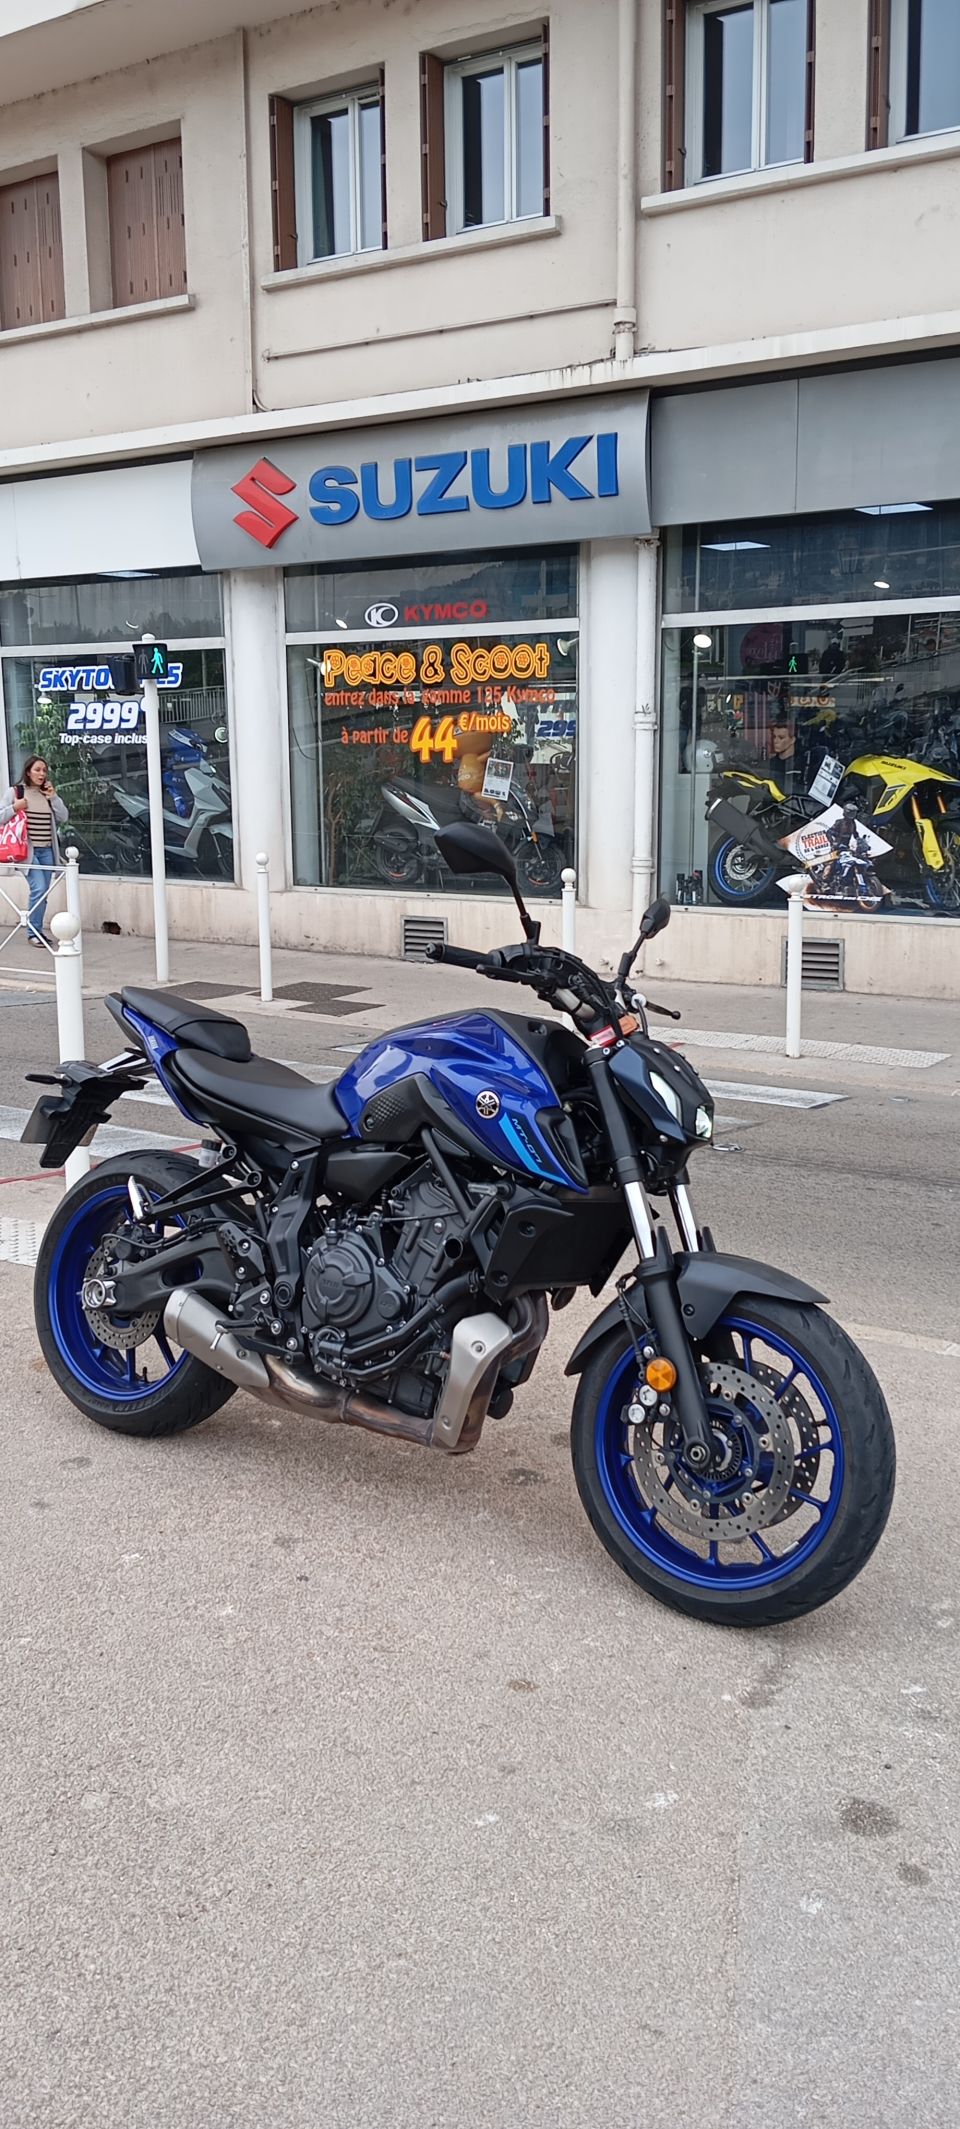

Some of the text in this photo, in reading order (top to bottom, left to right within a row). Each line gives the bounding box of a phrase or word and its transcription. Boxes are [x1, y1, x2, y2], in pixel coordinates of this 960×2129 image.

[308, 432, 619, 526] SUZUKI
[404, 600, 487, 622] KYMCO
[323, 643, 550, 687] Peace & Scoot
[324, 690, 365, 706] entrez
[368, 688, 399, 705] dans
[402, 687, 415, 704] la
[476, 686, 502, 703] 125
[506, 685, 556, 704] Kymco
[59, 732, 147, 745] Top-case inclus
[341, 712, 512, 764] à partir de 44 €/mois
[802, 835, 828, 848] TRAIL
[511, 1117, 542, 1164] MT-07
